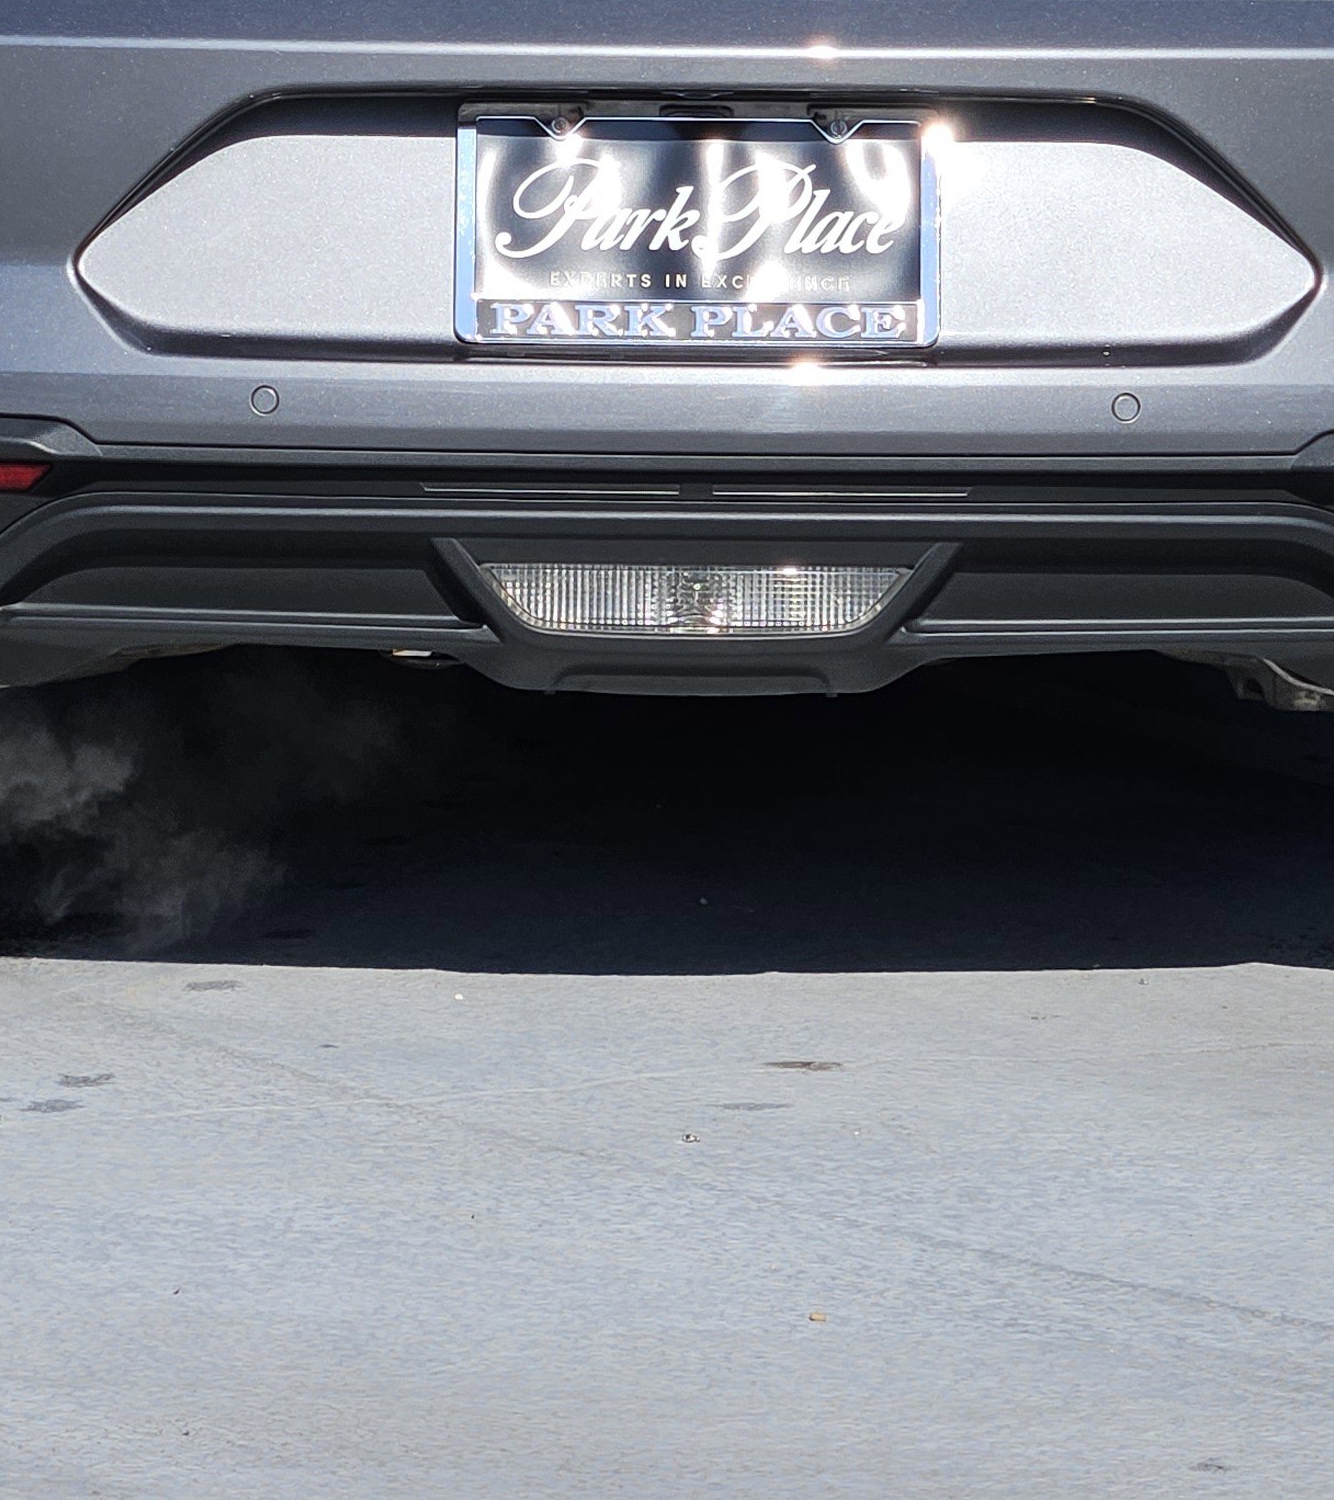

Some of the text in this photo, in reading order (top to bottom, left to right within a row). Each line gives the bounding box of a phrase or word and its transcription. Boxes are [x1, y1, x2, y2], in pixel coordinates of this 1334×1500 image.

[495, 157, 907, 261] Park Place
[550, 271, 652, 288] EXPERTS
[665, 274, 687, 288] IN
[490, 302, 907, 338] PARK PLACE
